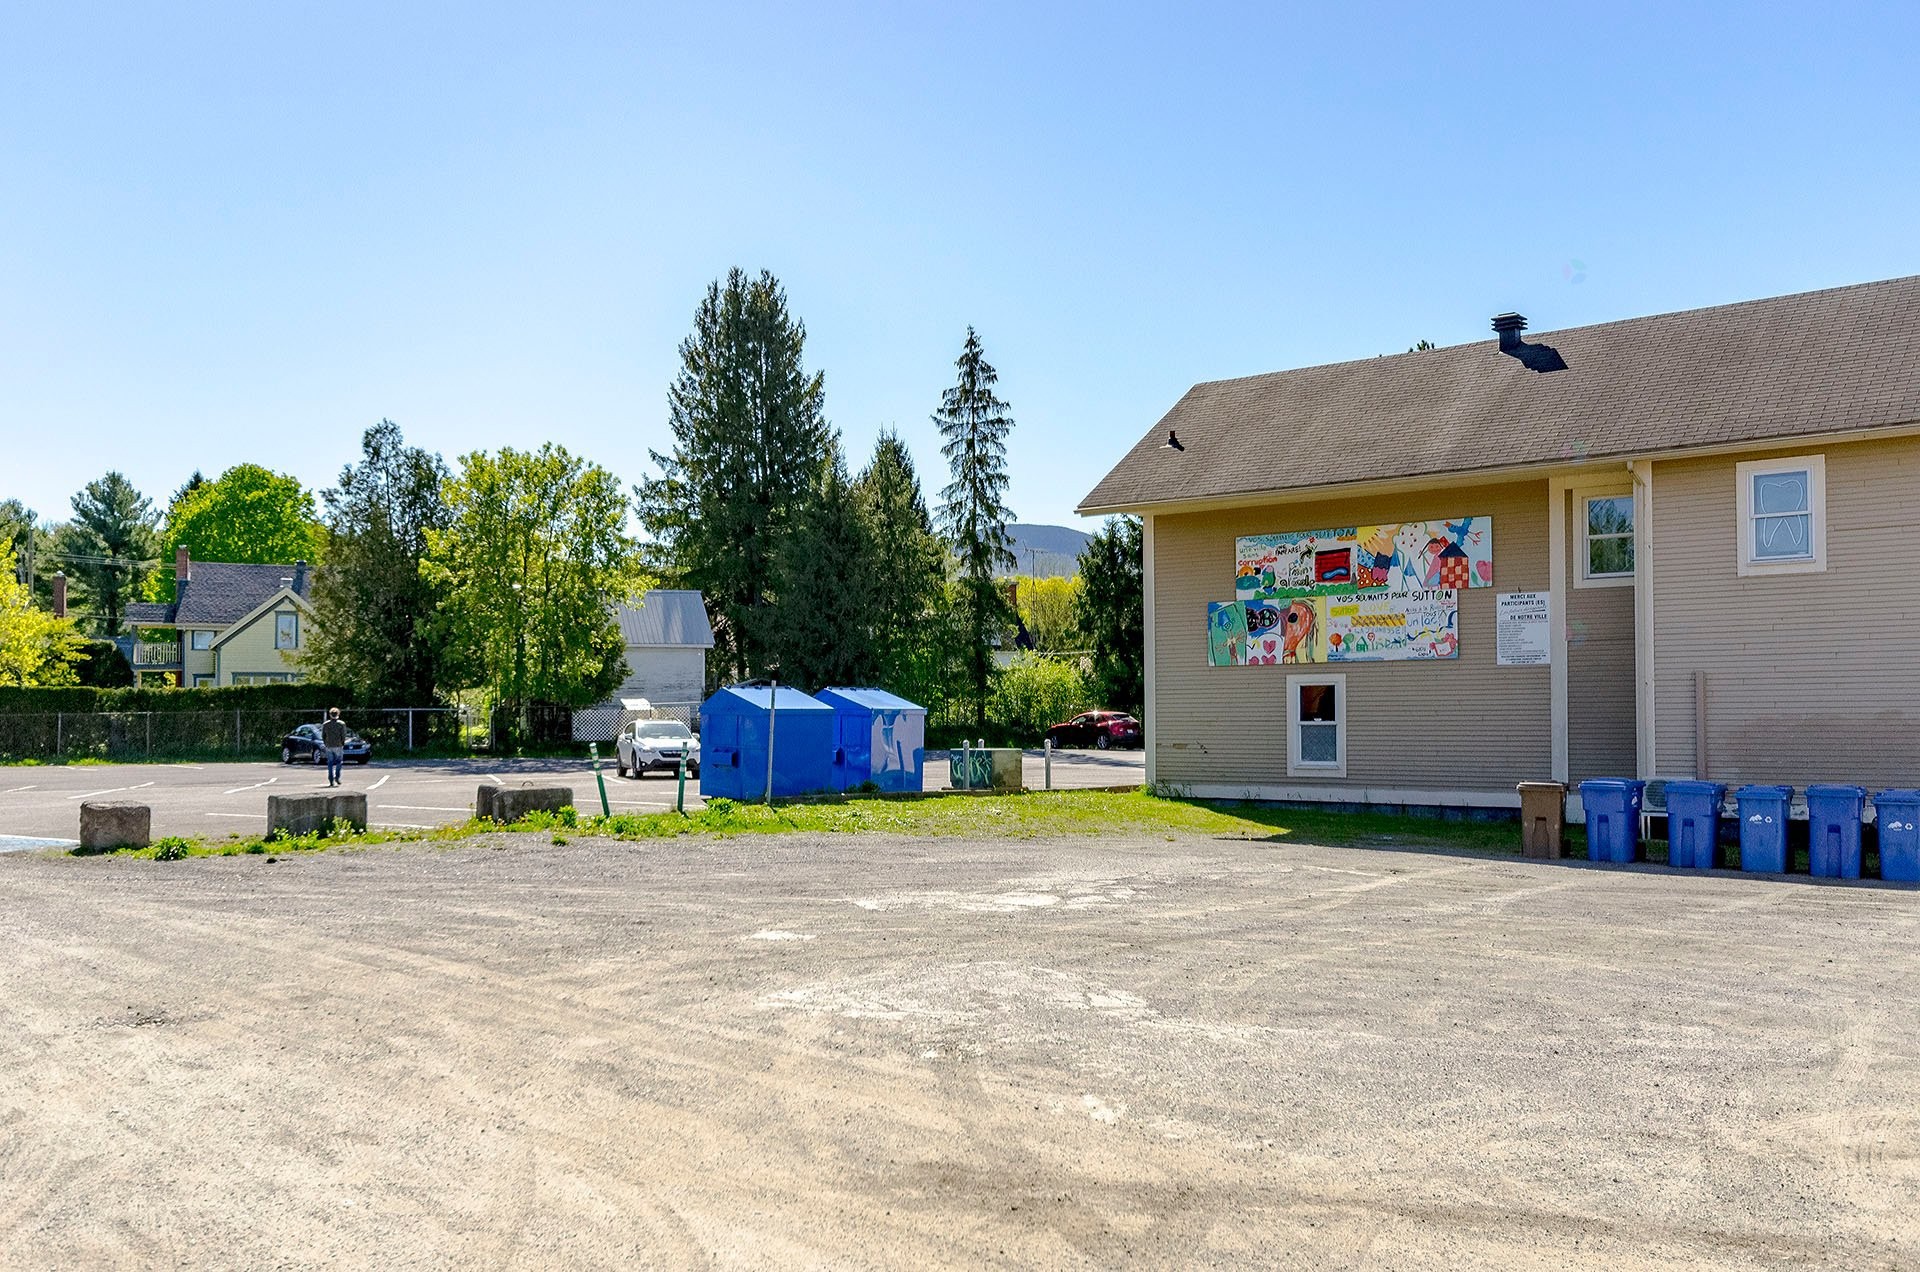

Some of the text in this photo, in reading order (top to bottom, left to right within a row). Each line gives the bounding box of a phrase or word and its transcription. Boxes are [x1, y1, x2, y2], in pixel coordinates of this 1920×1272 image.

[1315, 528, 1355, 539] SUTTON
[1238, 556, 1278, 567] corruption
[1336, 590, 1452, 603] VOS SOUHAITS POUR SUTTON
